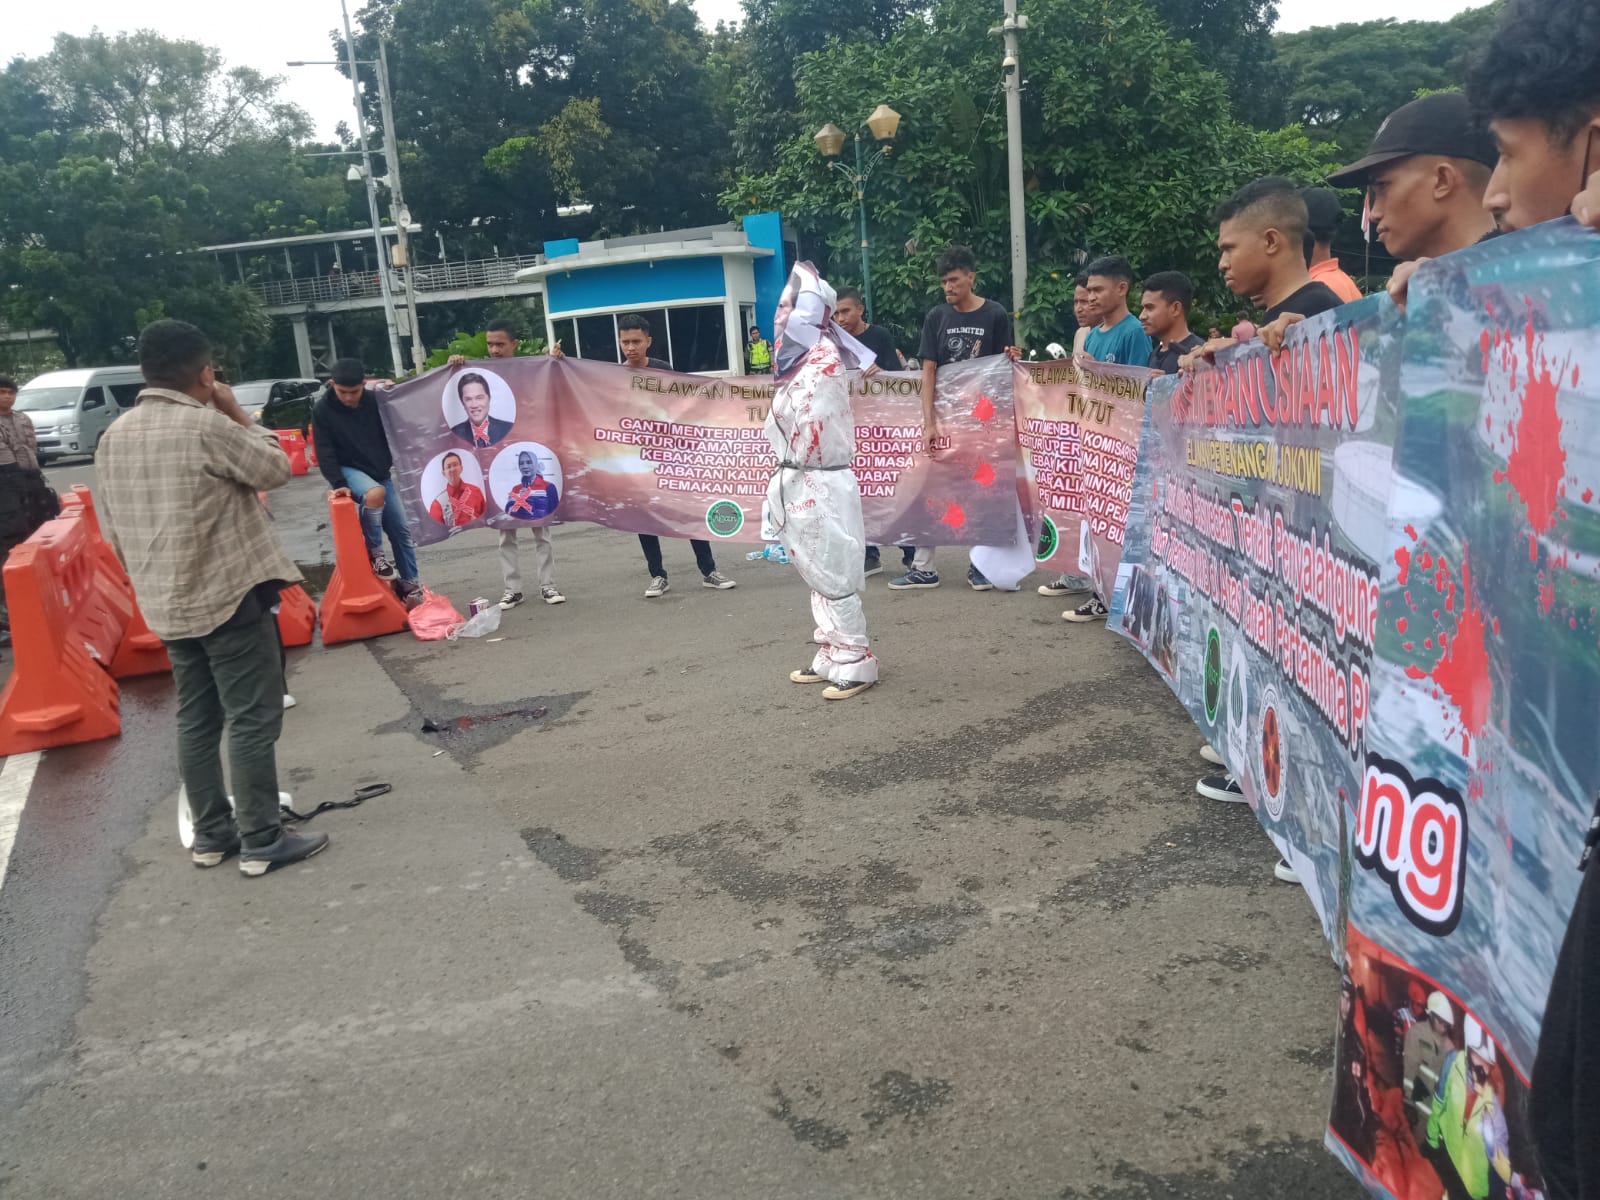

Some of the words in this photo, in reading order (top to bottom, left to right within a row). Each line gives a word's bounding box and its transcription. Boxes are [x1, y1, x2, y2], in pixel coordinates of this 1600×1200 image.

[946, 326, 985, 336] UNLIMITED
[631, 375, 724, 399] RELAWAN
[620, 418, 669, 435] GANTI
[671, 425, 738, 441] MENTERI
[873, 427, 923, 439] UTAMA
[595, 429, 674, 450] DIREKTUR
[676, 439, 731, 454] UTAMA
[861, 442, 912, 453] SUDAH
[641, 448, 736, 468] KEBAKARAN
[856, 456, 871, 468] DI
[874, 456, 914, 468] MASA
[655, 464, 724, 480] JABATAN
[856, 471, 900, 482] JABAT
[1278, 444, 1321, 497] JOKOWI
[658, 478, 734, 495] PEMAKAN
[1232, 498, 1274, 573] Terkait
[1275, 510, 1380, 652] Penyalahguna
[1275, 597, 1349, 742] Pertamina
